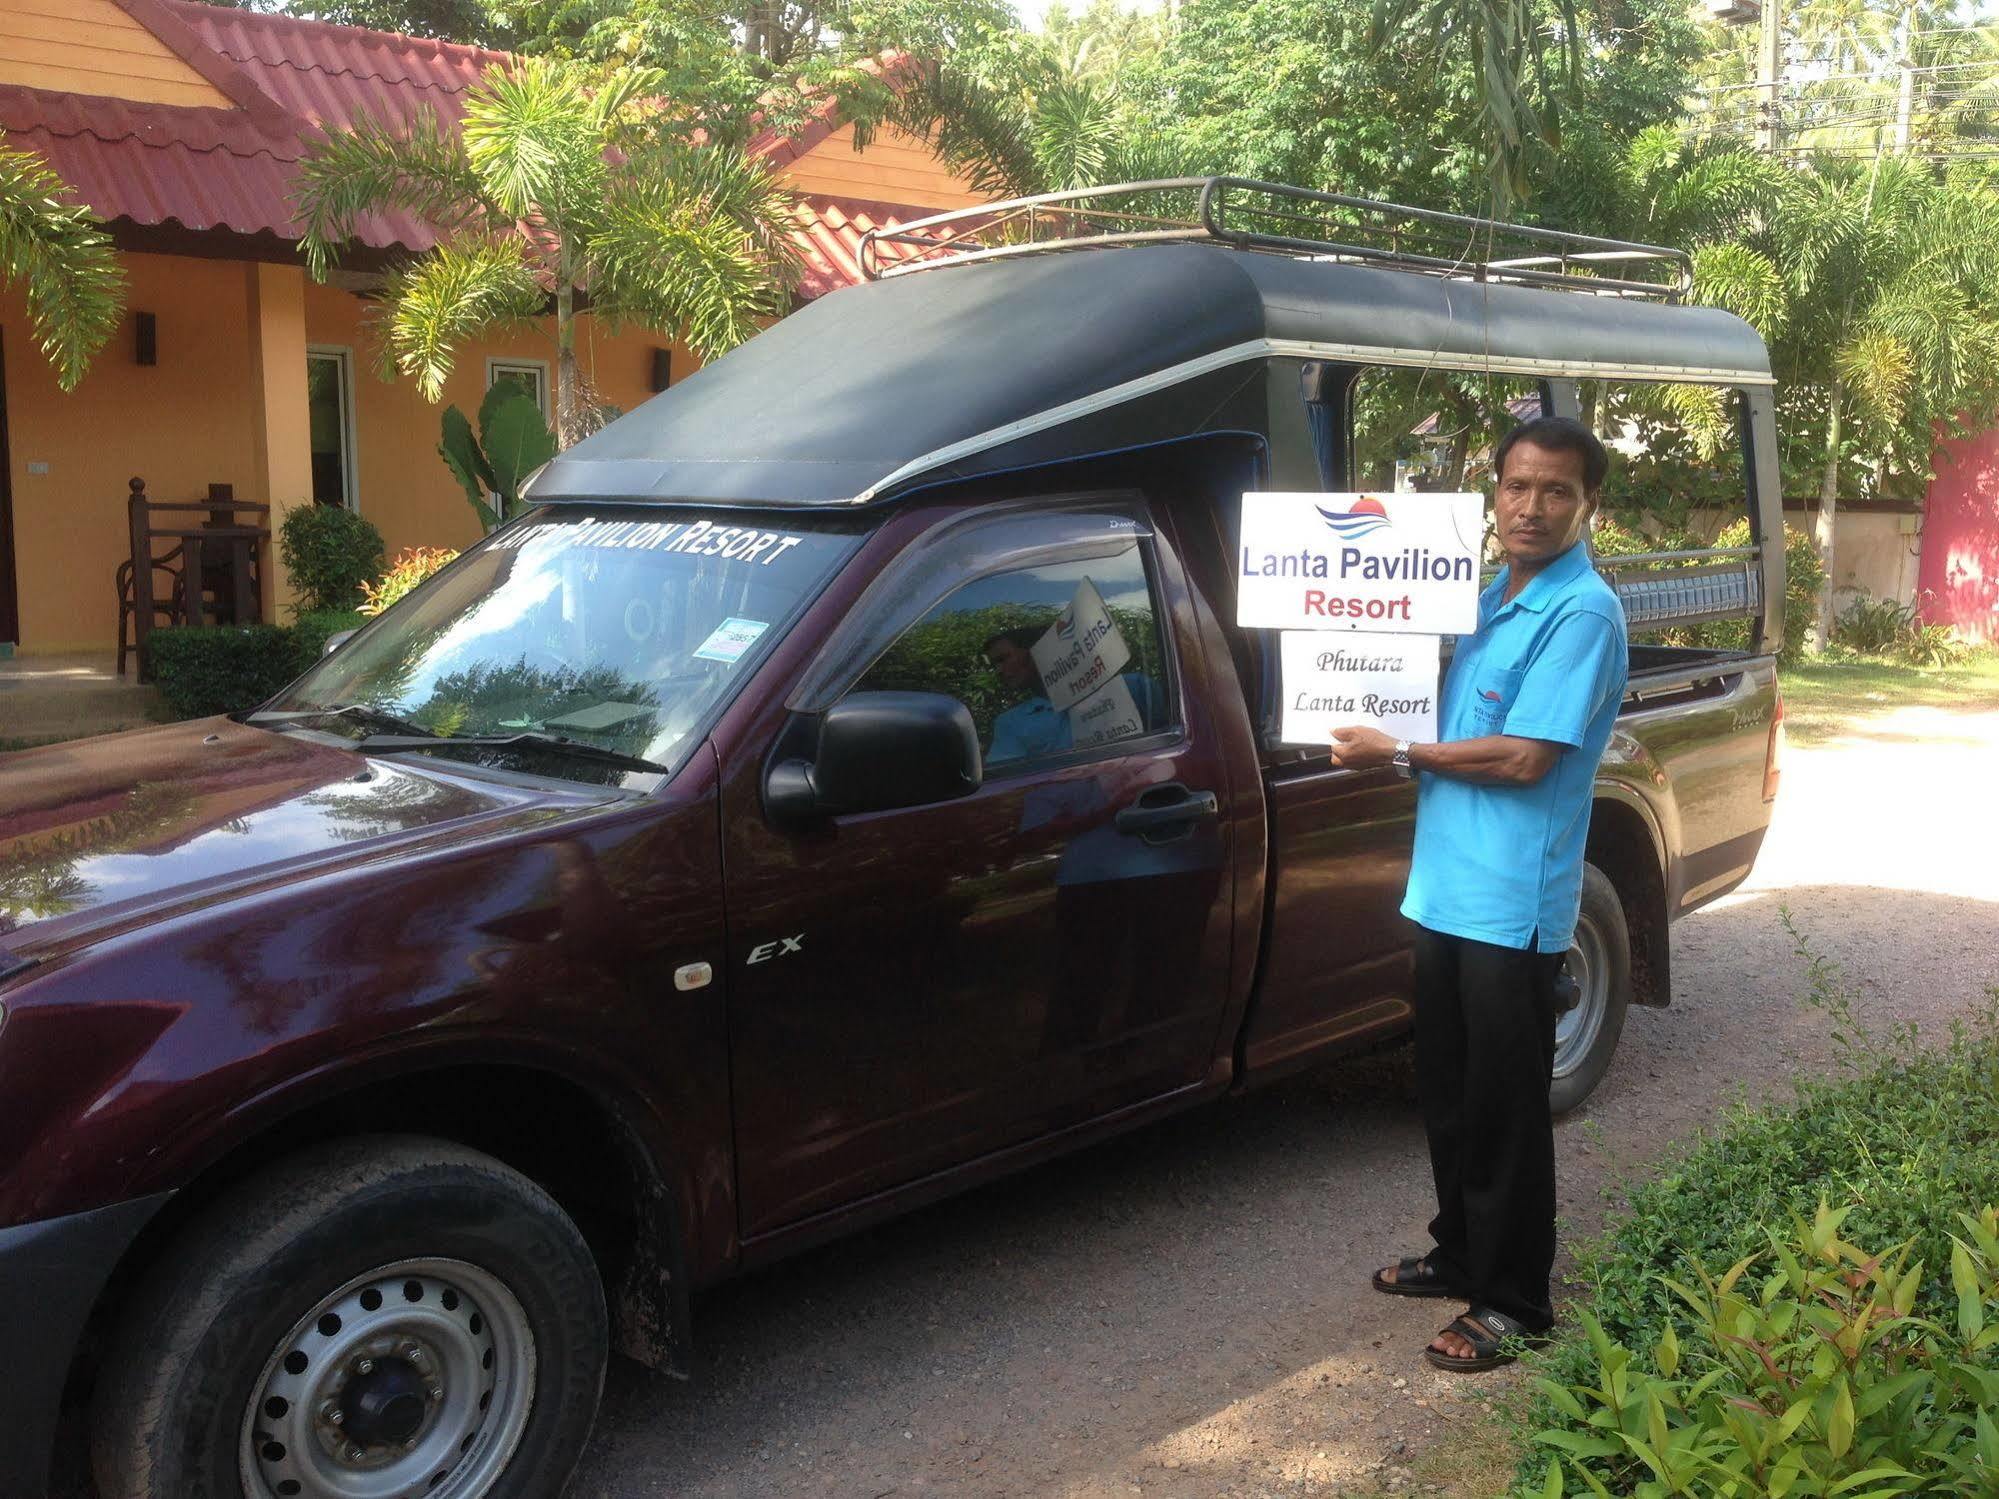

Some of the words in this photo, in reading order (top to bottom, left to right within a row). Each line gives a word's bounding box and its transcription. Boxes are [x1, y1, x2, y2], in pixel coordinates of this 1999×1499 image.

[563, 517, 683, 549] PAVILION
[664, 520, 803, 566] RESORT
[1243, 547, 1328, 578] Lanta
[1340, 547, 1473, 581] Pavilion
[1304, 590, 1411, 620] Resort
[1316, 650, 1404, 673] Phutara
[1293, 692, 1356, 713] Lanta
[1362, 693, 1431, 718] Resort
[746, 932, 806, 965] EX
